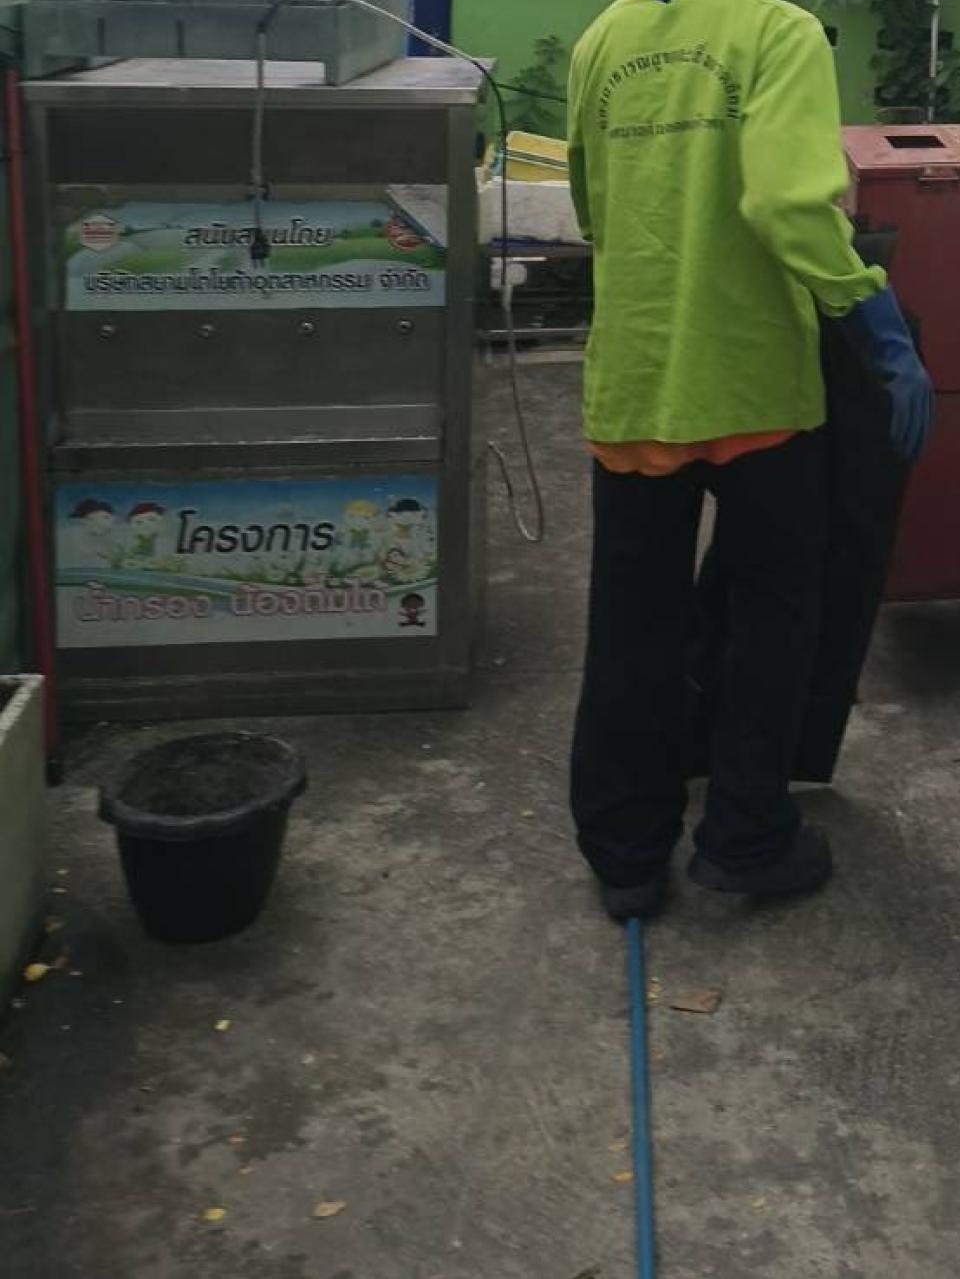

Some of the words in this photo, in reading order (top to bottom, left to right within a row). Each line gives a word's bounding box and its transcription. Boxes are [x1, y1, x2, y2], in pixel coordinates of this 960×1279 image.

[379, 268, 430, 290] จำกัด
[175, 509, 336, 554] โครงการ
